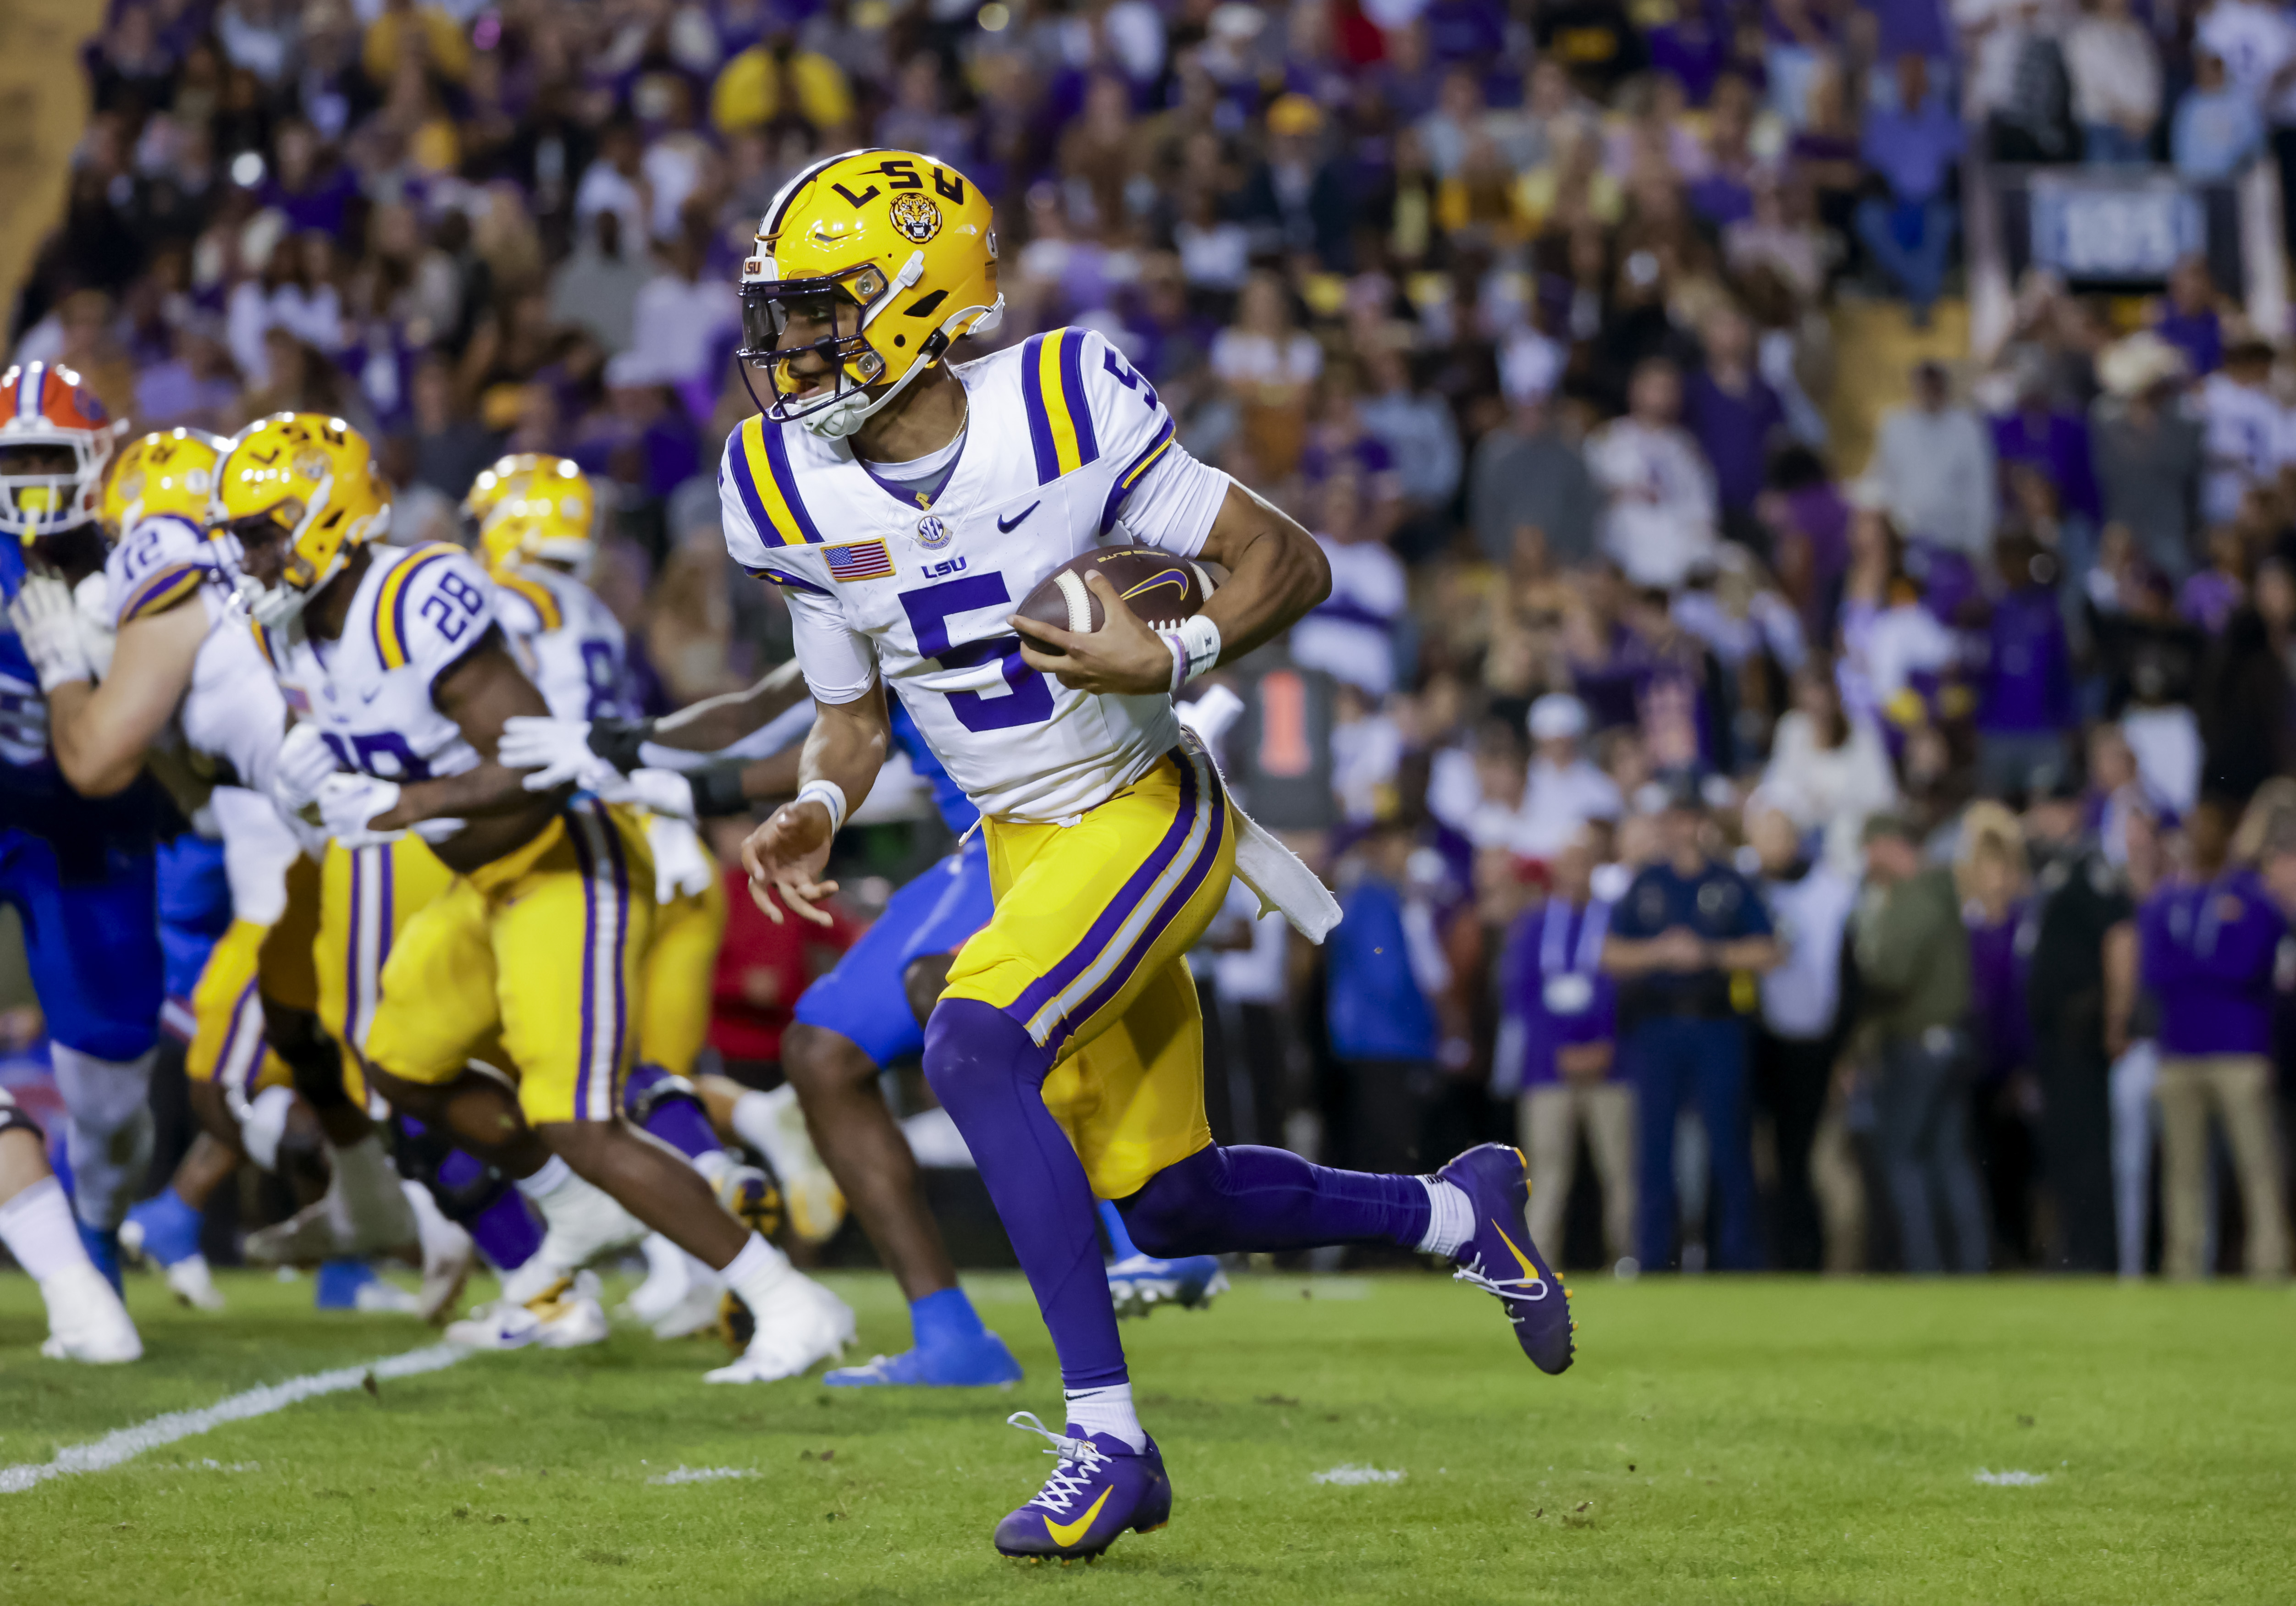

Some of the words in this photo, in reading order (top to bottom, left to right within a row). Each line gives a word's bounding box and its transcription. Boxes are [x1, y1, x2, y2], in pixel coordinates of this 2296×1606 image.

[831, 160, 964, 209] LSU
[744, 261, 762, 275] LSU
[919, 517, 944, 541] SEC
[922, 534, 950, 549] GRADUATE
[921, 556, 967, 579] LSU
[421, 571, 484, 643] 28
[897, 570, 1055, 733] 5
